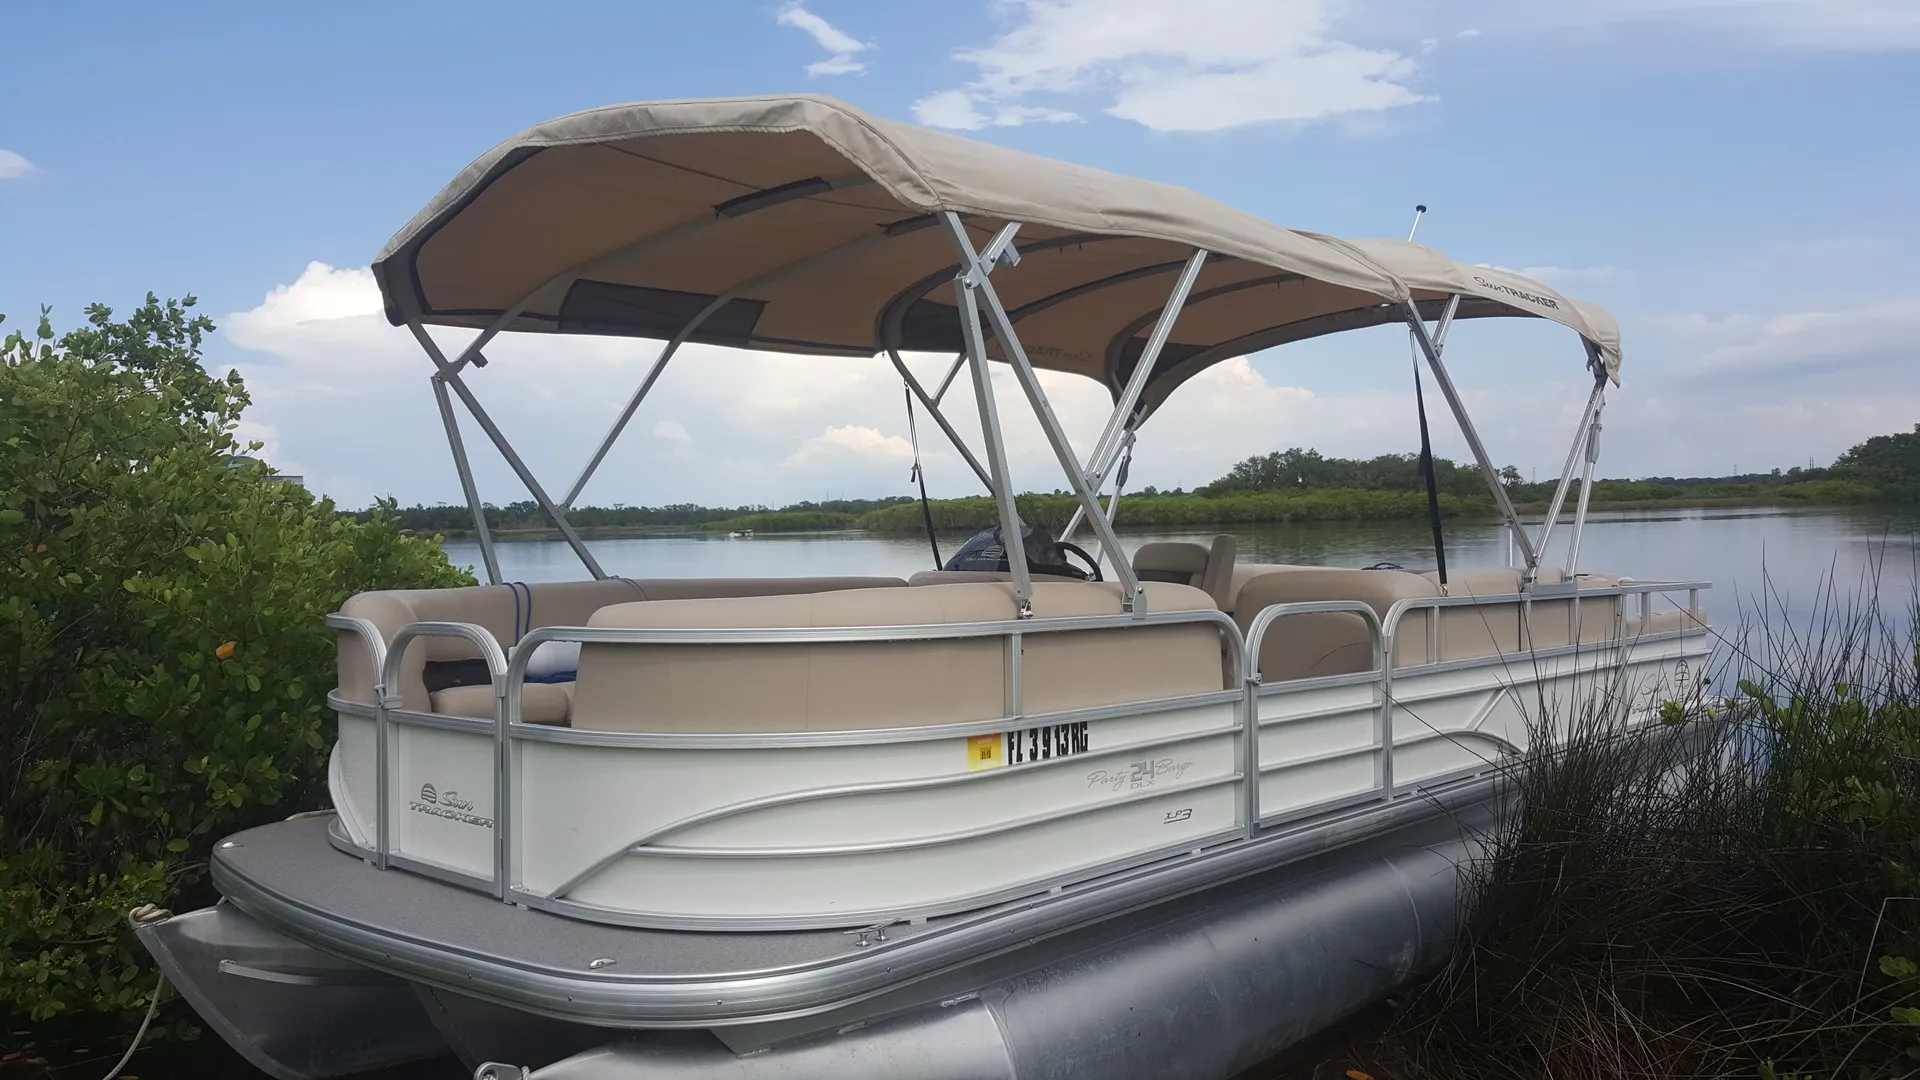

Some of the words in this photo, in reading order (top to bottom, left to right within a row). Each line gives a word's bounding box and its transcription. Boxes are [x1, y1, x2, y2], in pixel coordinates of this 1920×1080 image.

[1007, 730, 1023, 765] FL
[1087, 770, 1129, 792] Party
[1130, 760, 1154, 782] 24
[1155, 758, 1193, 780] Barge
[1130, 781, 1154, 789] DLX
[409, 801, 494, 828] TRACKER
[438, 791, 474, 811] Sun
